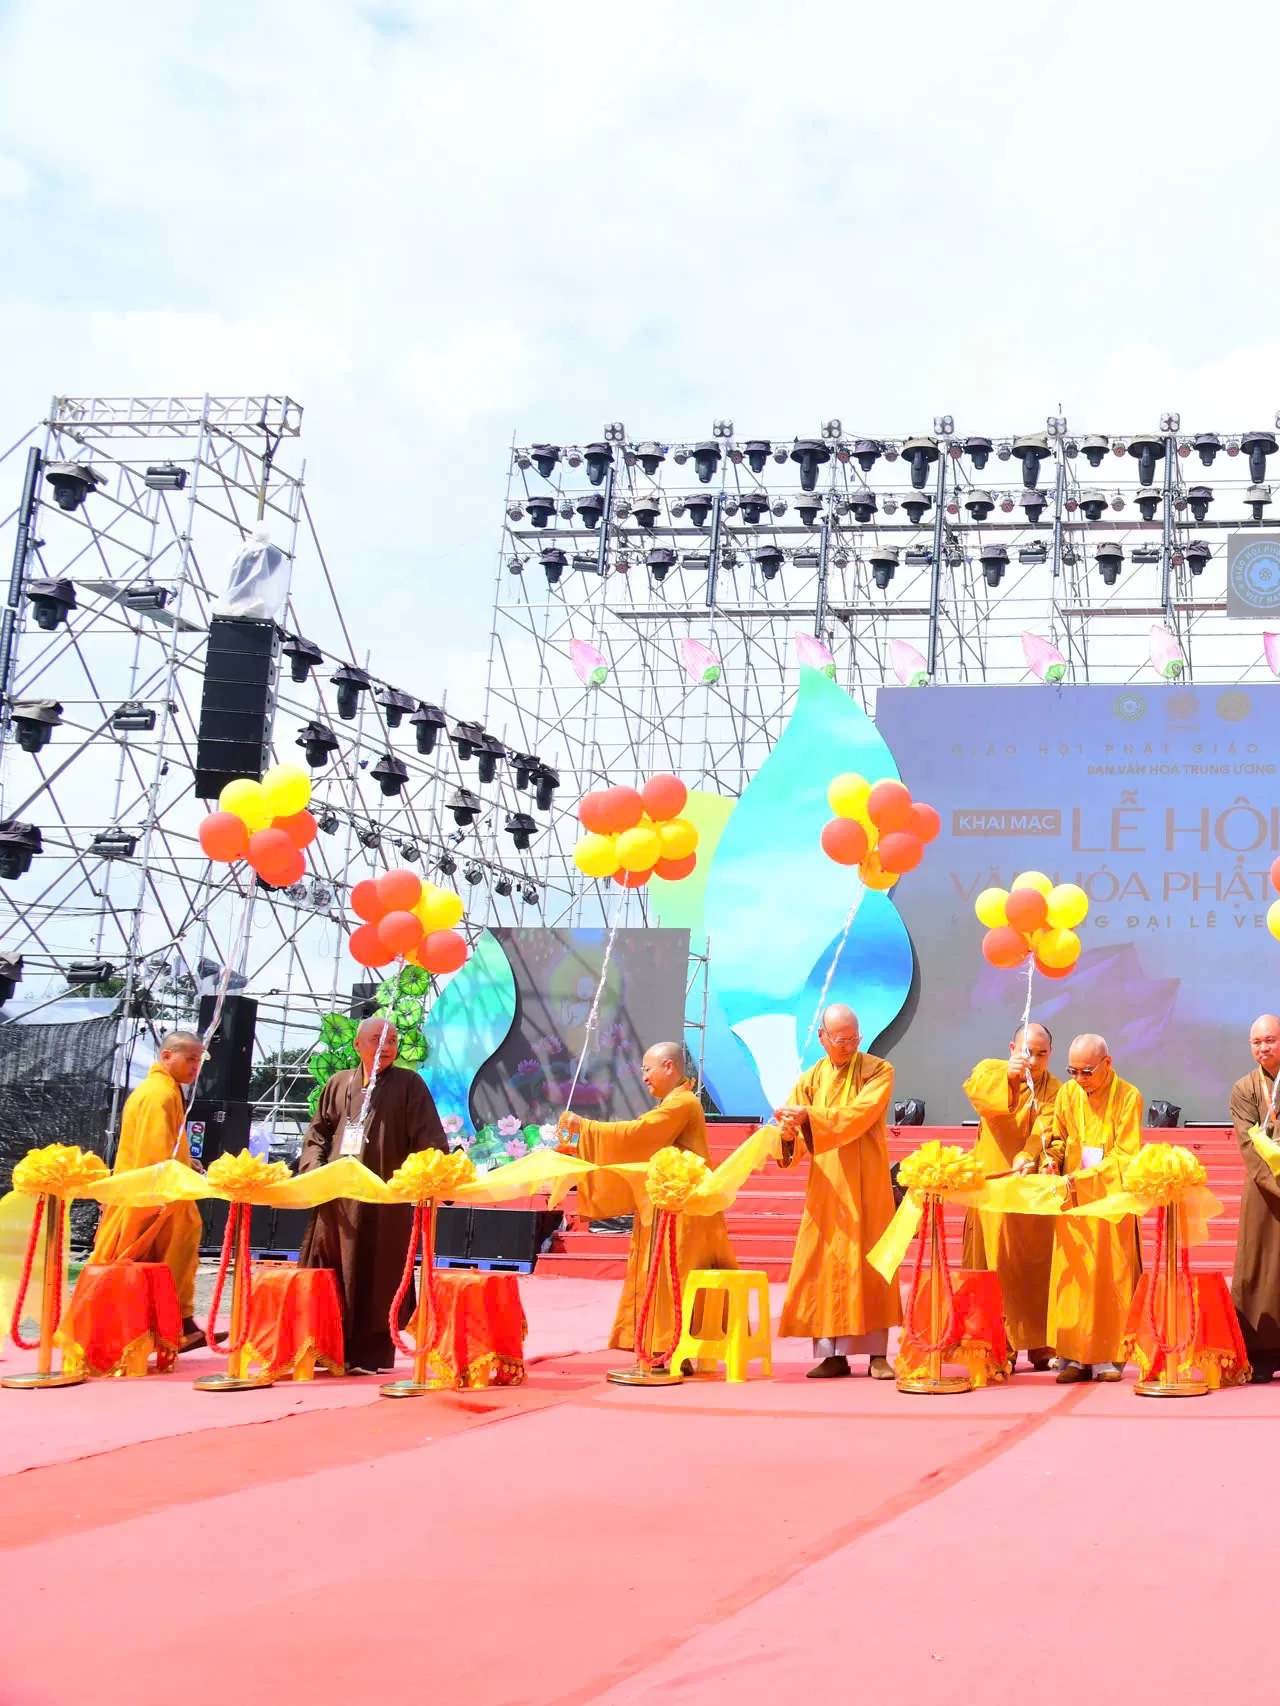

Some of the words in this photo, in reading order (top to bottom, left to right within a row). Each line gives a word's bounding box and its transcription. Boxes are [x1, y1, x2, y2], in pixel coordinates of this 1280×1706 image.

[1087, 764, 1115, 775] BAN
[1183, 764, 1231, 775] TRUNG
[959, 815, 1006, 830] KHAI
[1010, 815, 1056, 833] MẠC
[1071, 789, 1148, 853] LỄ
[1164, 796, 1280, 863] HỘI
[1126, 915, 1172, 932] ĐẠI
[191, 1123, 203, 1155] HNE
